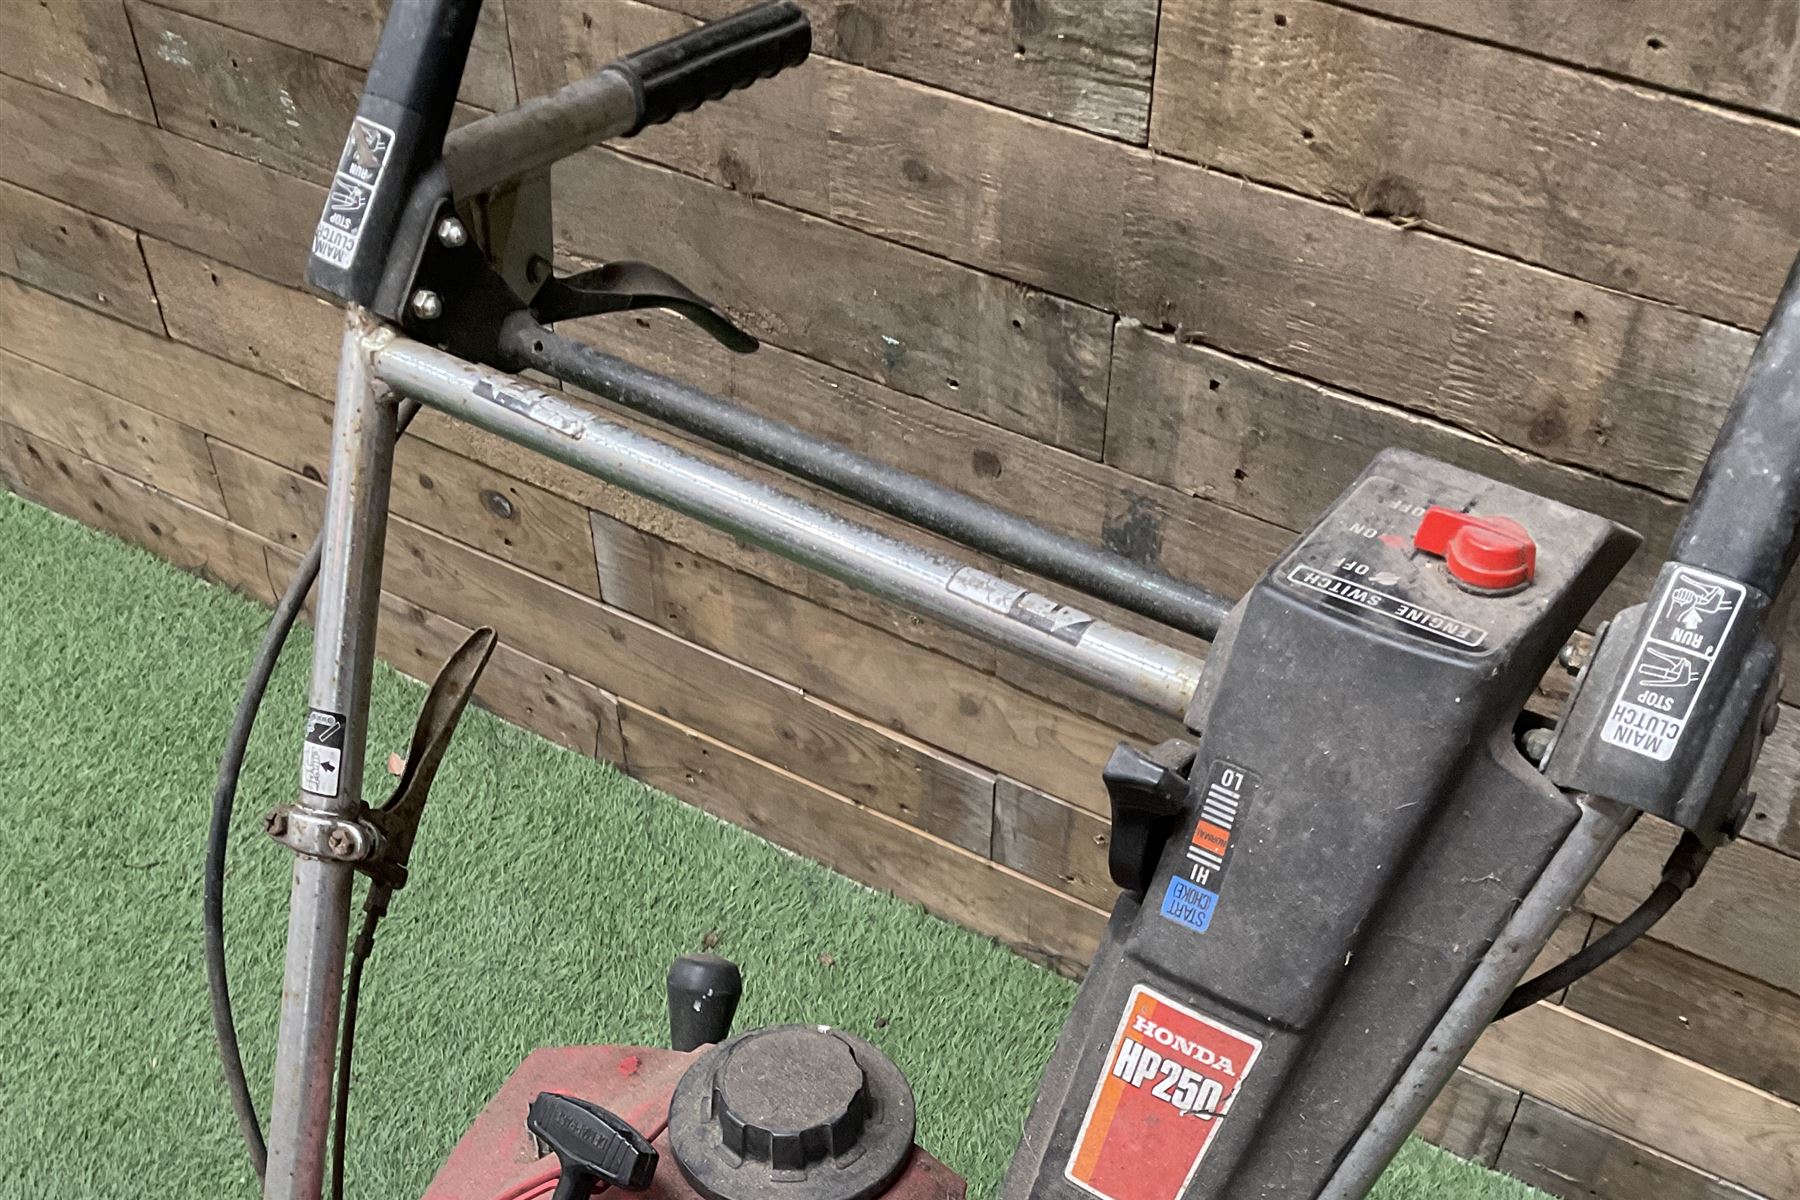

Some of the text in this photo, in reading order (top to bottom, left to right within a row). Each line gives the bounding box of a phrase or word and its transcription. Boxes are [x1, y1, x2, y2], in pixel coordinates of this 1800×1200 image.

[329, 212, 352, 229] STOP
[315, 224, 354, 251] CLUTCH
[314, 240, 345, 262] MAIN
[1389, 499, 1425, 517] OFF
[1348, 521, 1379, 539] ON
[1331, 555, 1371, 575] OFF
[1302, 570, 1473, 639] ENGINE SWITCH
[1669, 626, 1704, 649] RUN
[1636, 690, 1674, 711] STOP
[1611, 704, 1680, 739] CLUTCH
[1612, 724, 1663, 753] MAIN
[1221, 768, 1244, 791] LO
[1189, 864, 1210, 885] HI
[1171, 881, 1212, 911] (CHOKE)
[1167, 900, 1206, 927] START
[1132, 1015, 1236, 1077] HONDA
[1111, 1038, 1224, 1121] HP250
